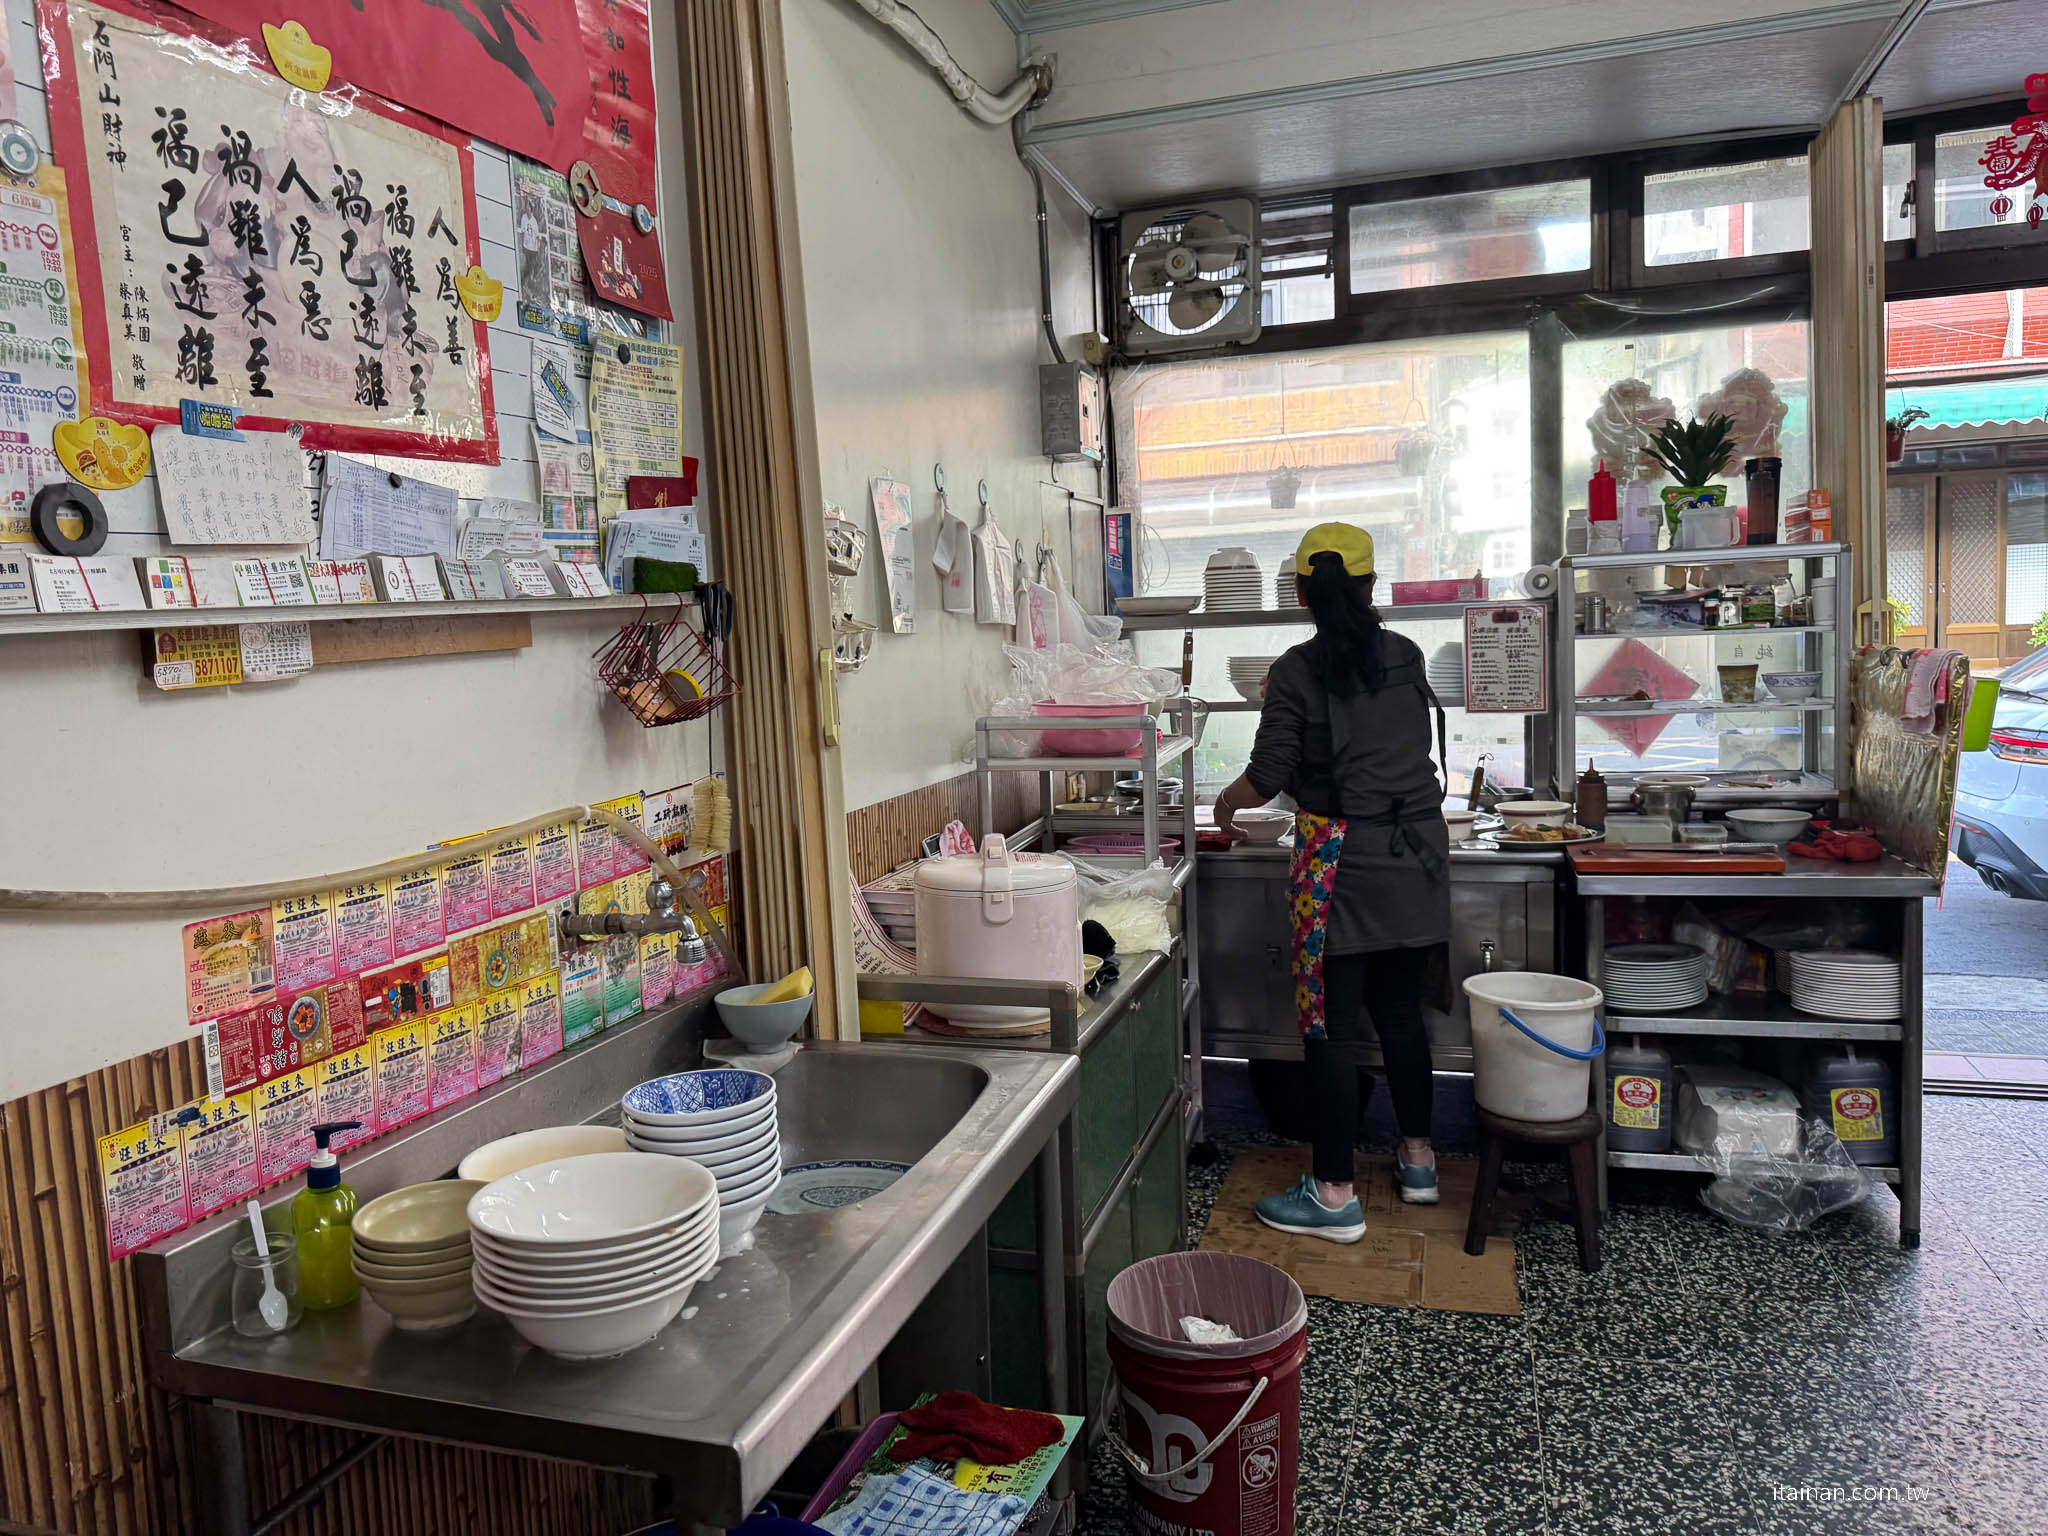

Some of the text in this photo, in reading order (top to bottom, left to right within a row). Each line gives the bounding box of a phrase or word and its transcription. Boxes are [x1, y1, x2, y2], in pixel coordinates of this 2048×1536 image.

[91, 19, 127, 173] 石門山財神
[132, 354, 147, 391] 敬贈
[195, 657, 238, 676] 5871107
[193, 914, 263, 949] 燕麥片
[1252, 1429, 1277, 1445] AVISO
